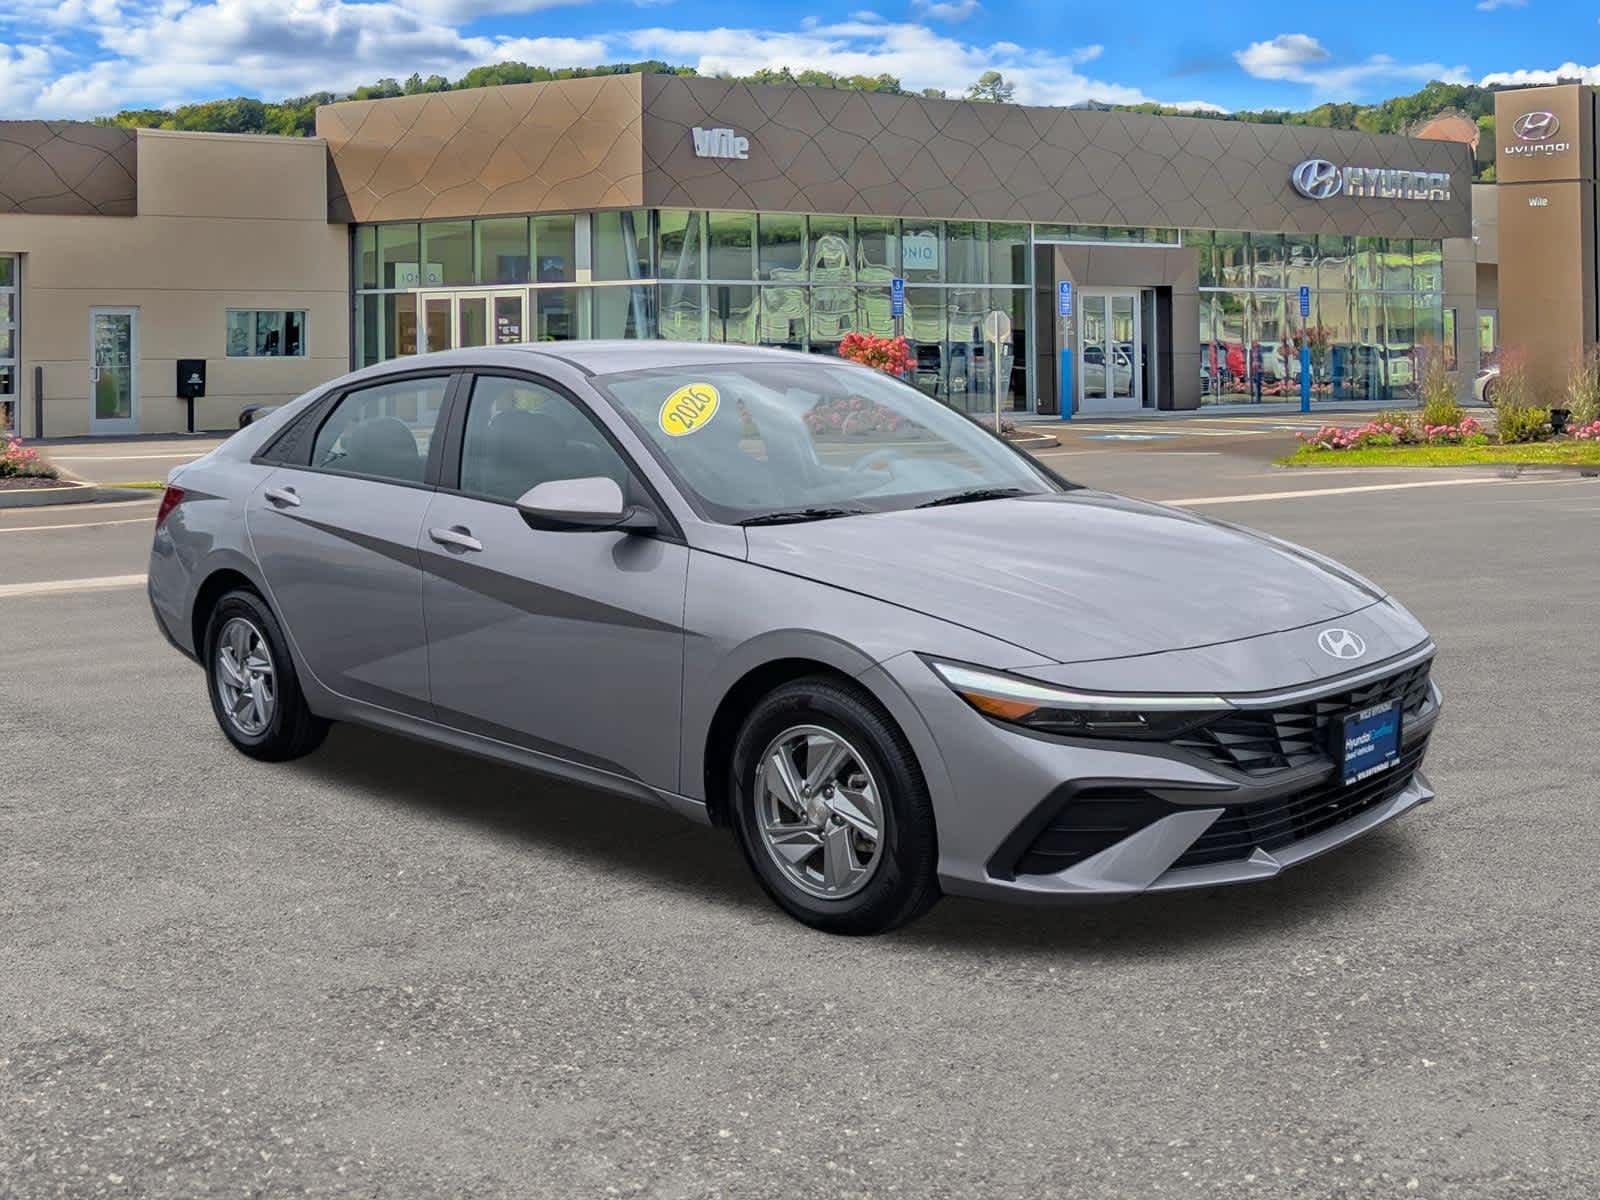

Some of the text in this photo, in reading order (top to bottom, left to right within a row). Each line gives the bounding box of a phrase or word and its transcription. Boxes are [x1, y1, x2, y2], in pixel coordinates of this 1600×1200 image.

[692, 127, 749, 159] Wile
[1343, 167, 1450, 201] HYUNDAI
[669, 388, 711, 428] 2026
